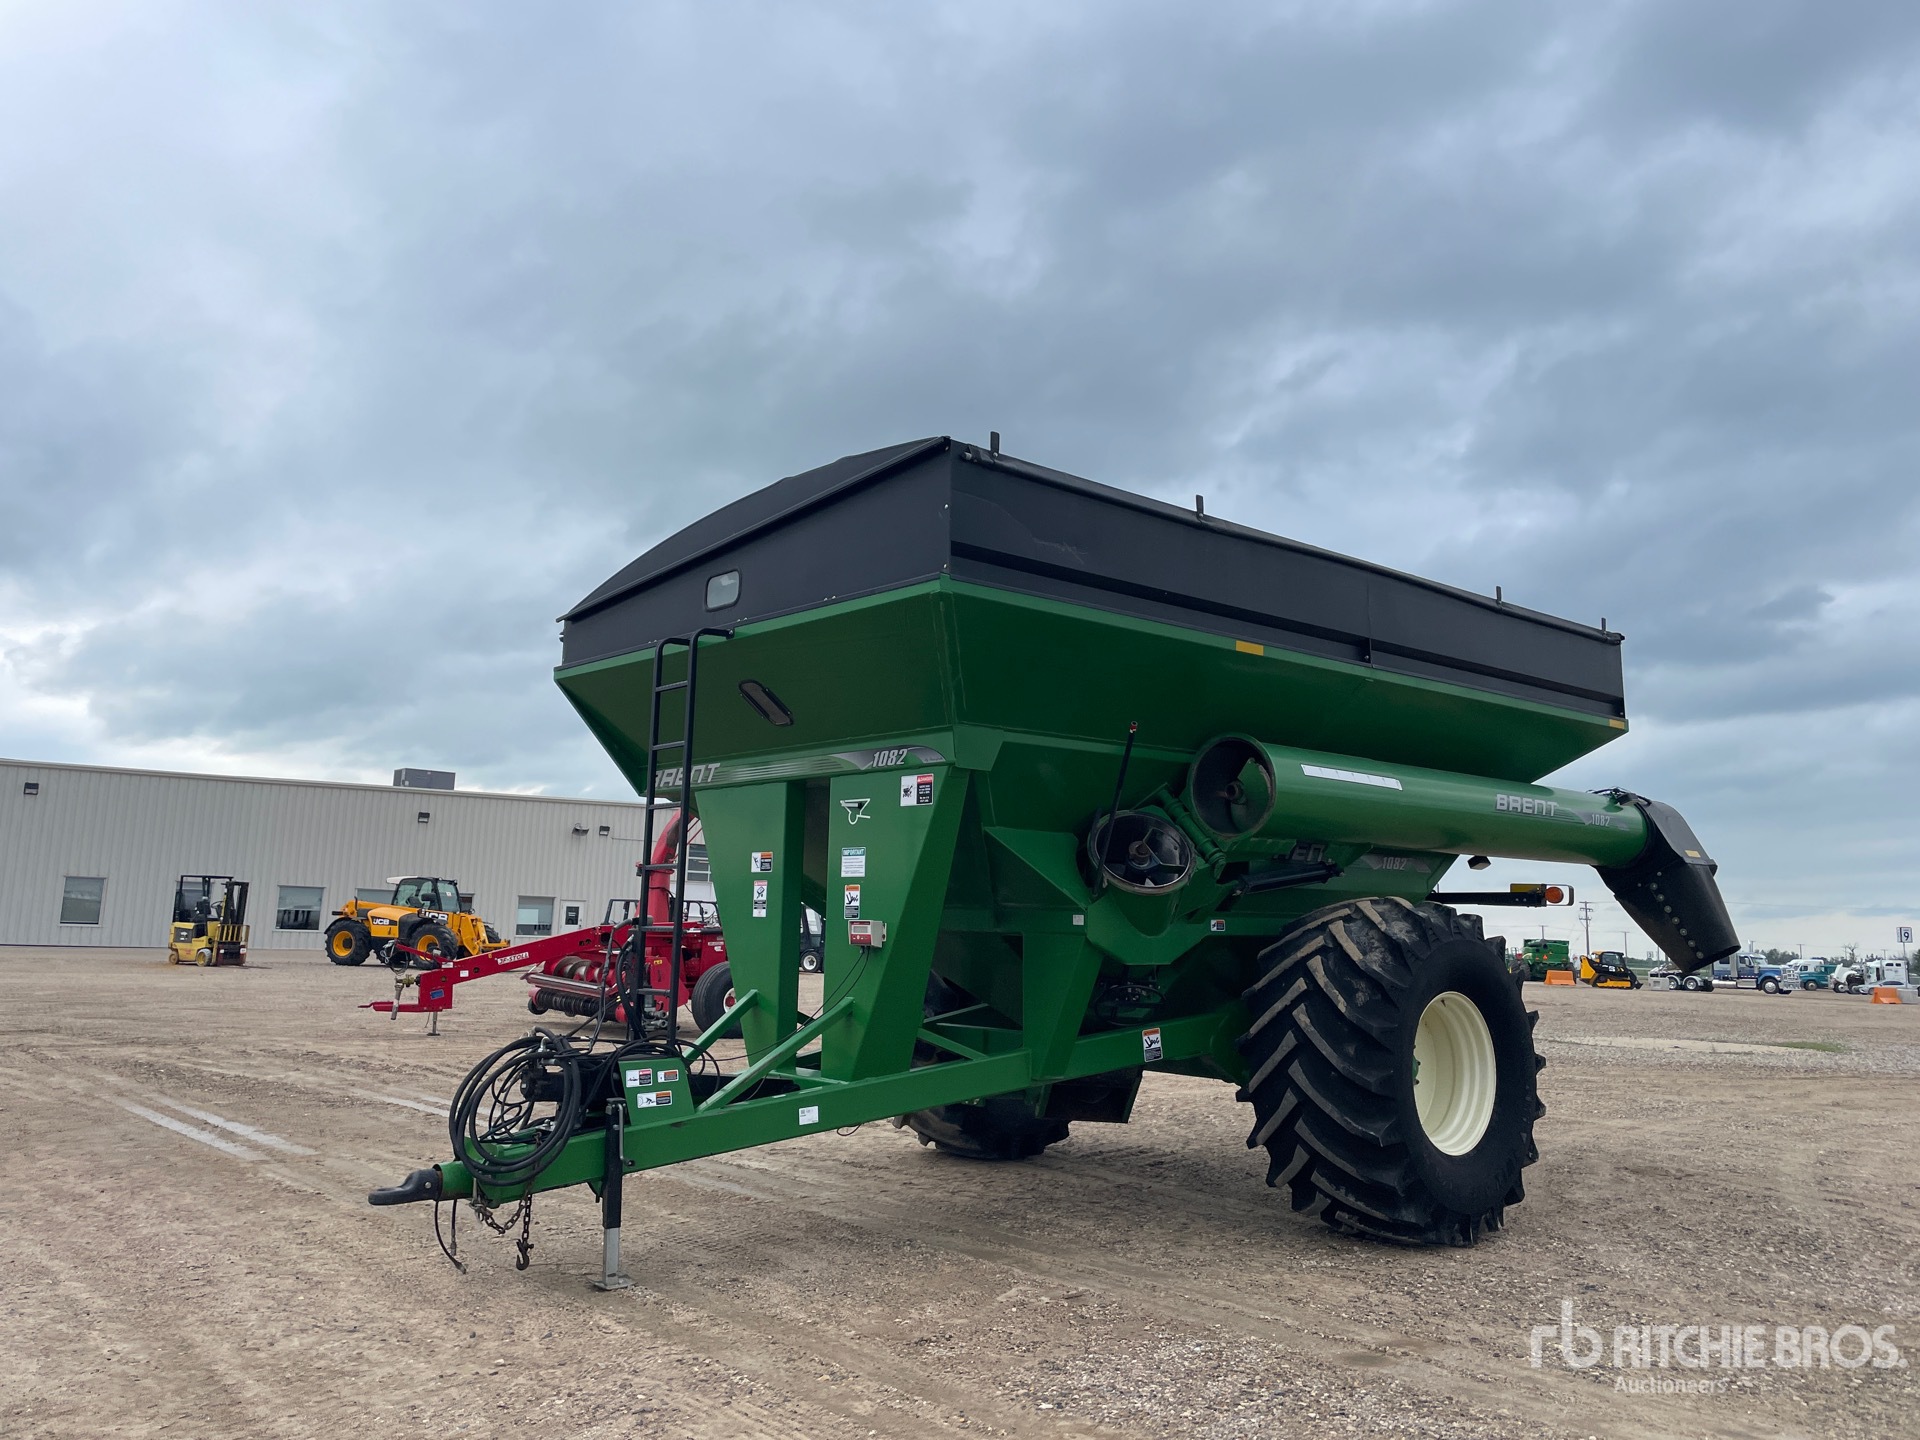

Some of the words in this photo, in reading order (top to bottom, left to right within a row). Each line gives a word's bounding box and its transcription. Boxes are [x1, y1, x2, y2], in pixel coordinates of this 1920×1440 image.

[872, 748, 908, 768] 1082
[1496, 794, 1558, 816] BRENT
[1591, 814, 1611, 827] 1082
[1382, 857, 1407, 870] 1082
[1903, 931, 1909, 941] 9
